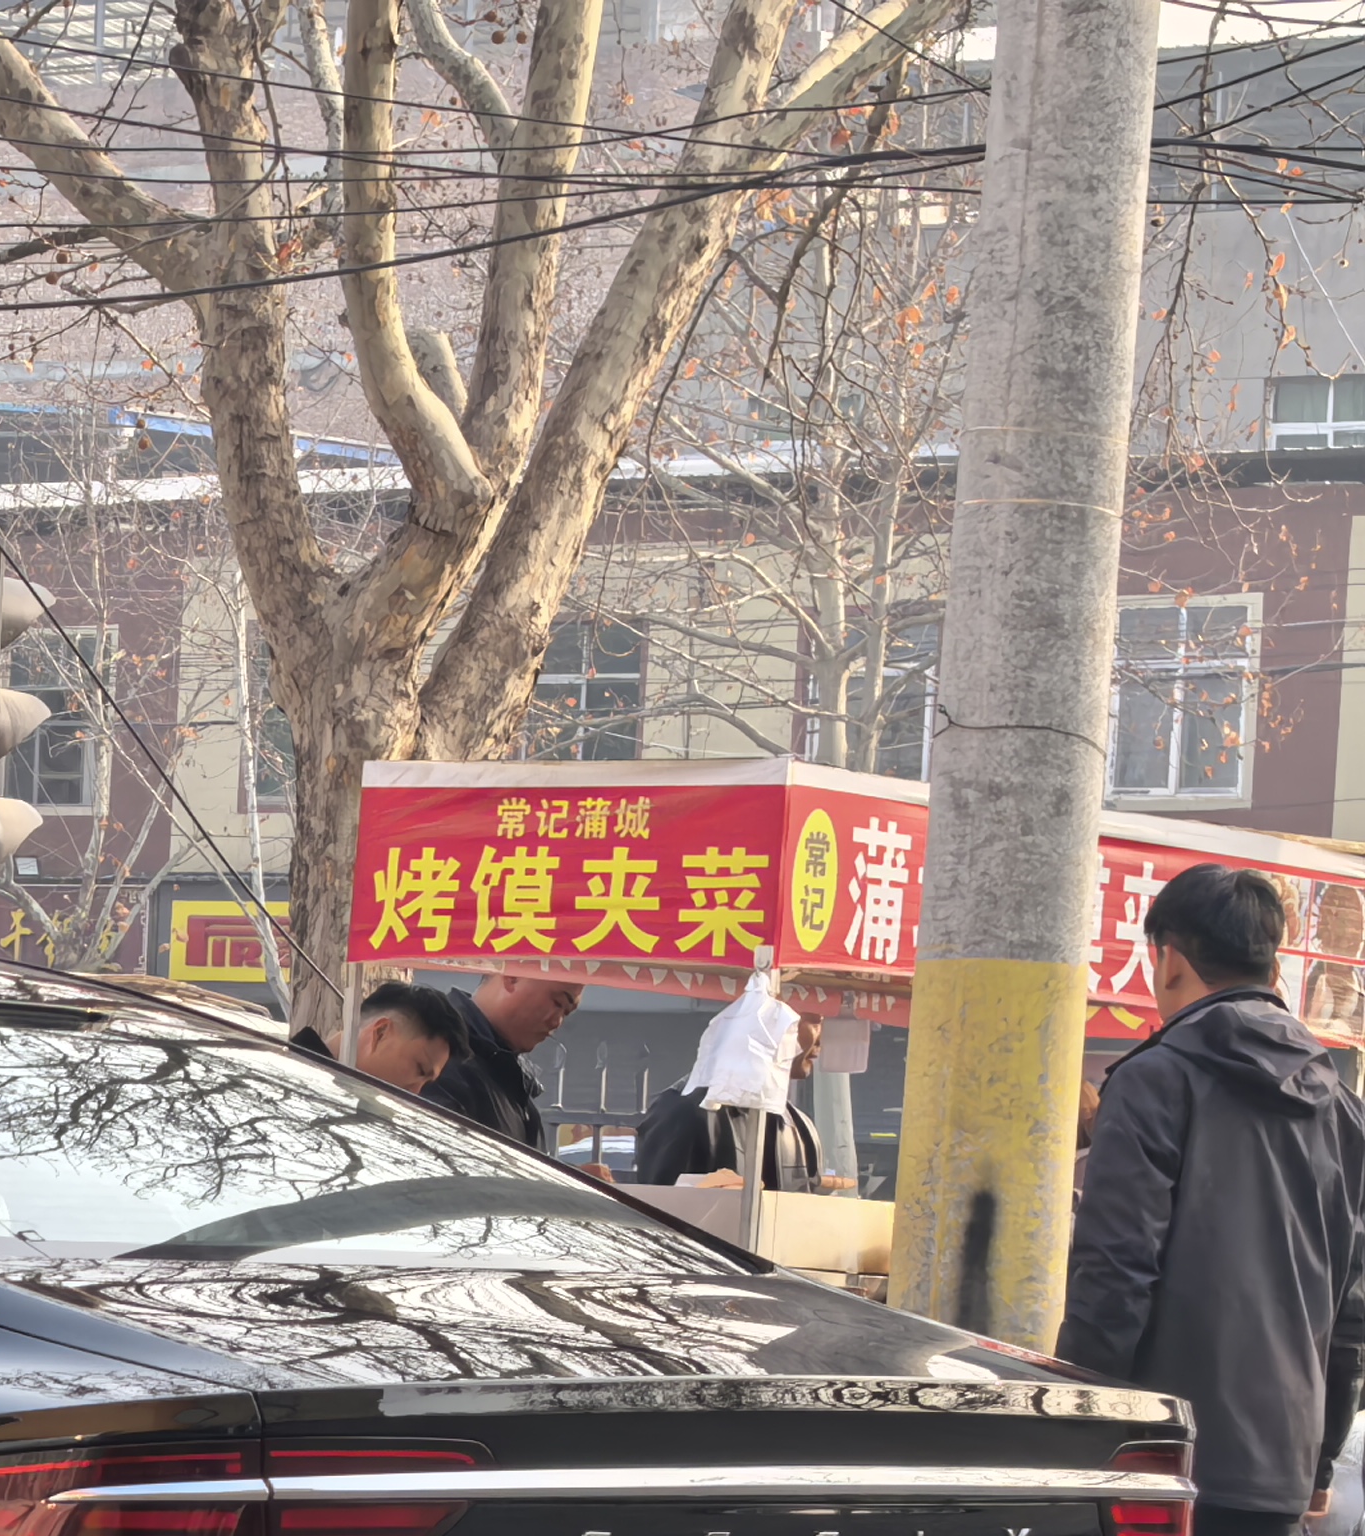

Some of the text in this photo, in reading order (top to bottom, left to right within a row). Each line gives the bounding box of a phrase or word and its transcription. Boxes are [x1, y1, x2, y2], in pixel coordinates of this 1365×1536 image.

[497, 797, 651, 839] 常记蒲城
[369, 845, 769, 957] 烤馍夹菜
[800, 831, 830, 931] 常记
